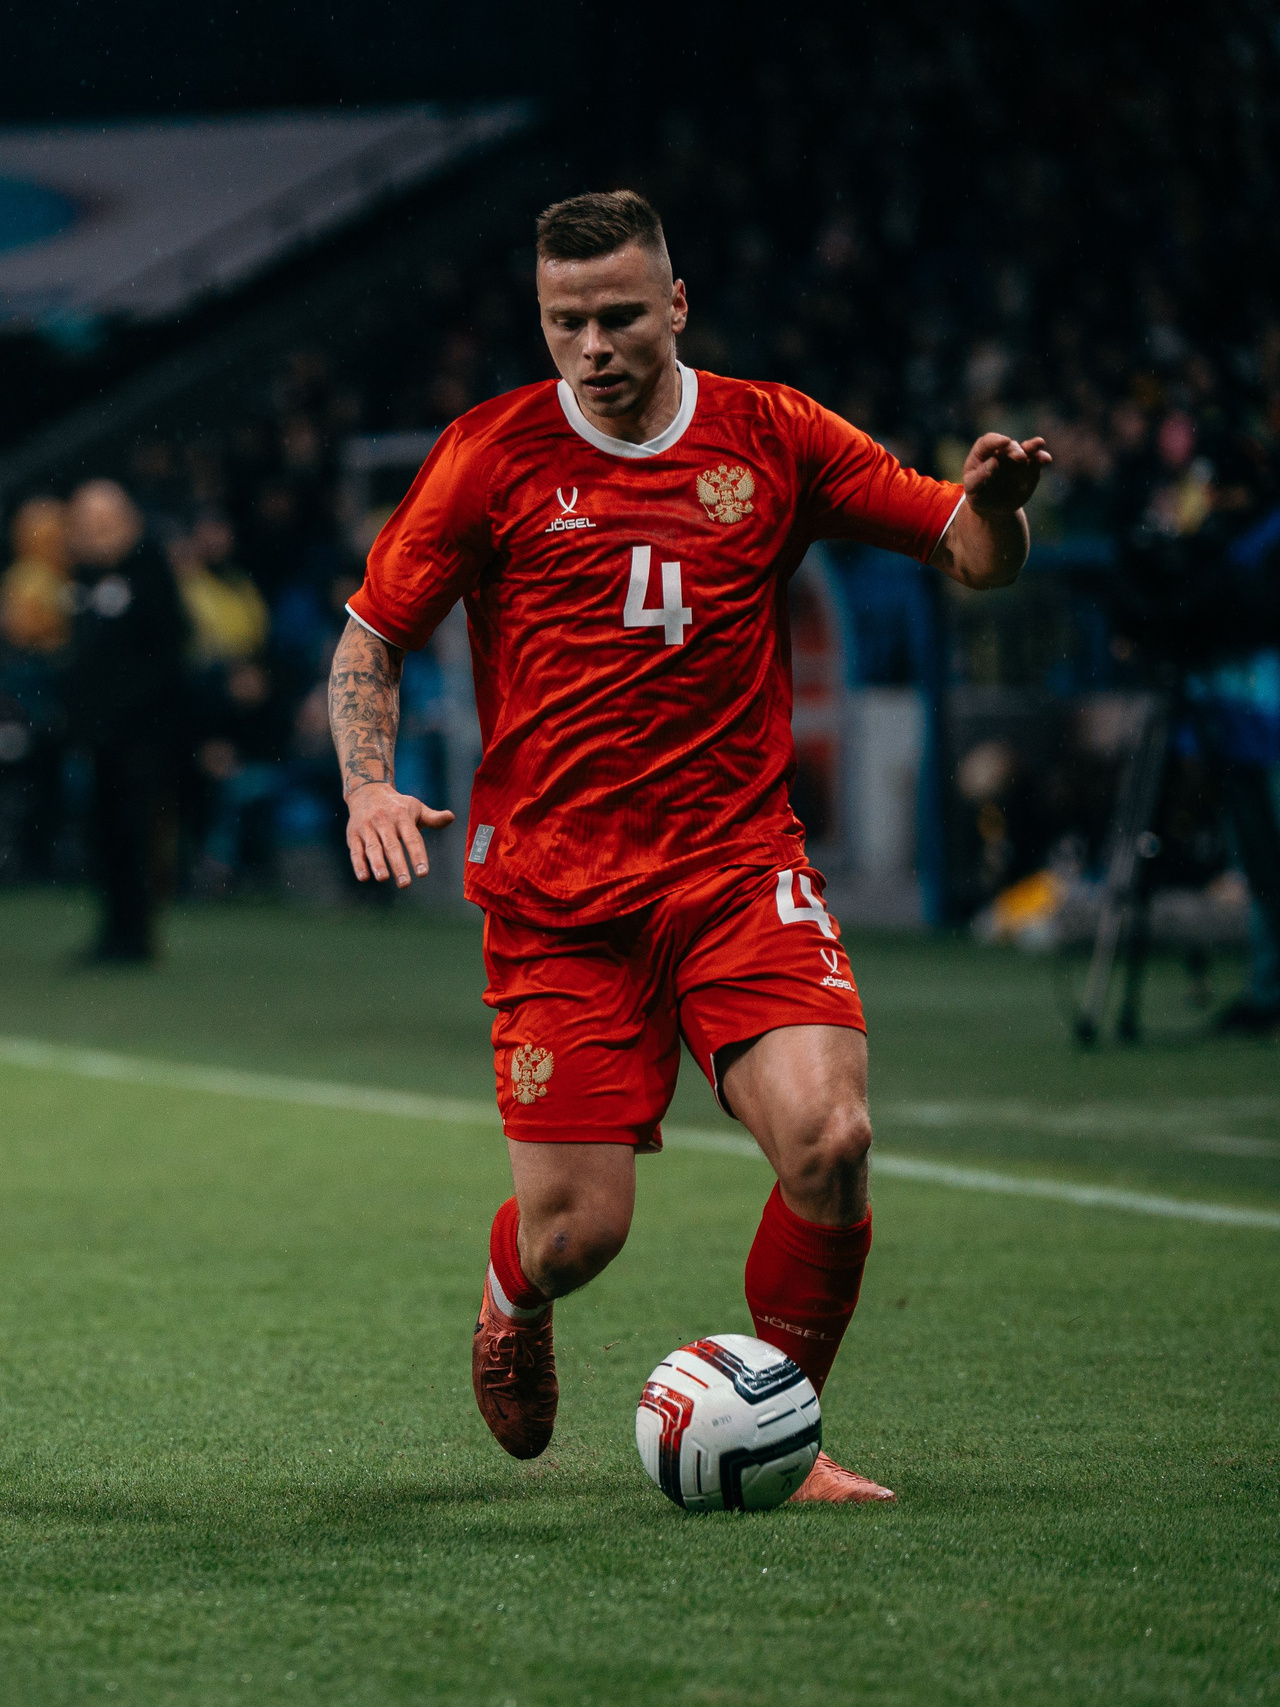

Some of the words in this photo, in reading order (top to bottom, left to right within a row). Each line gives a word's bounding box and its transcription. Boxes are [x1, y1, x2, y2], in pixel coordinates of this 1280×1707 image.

[545, 518, 597, 533] JÖGEL
[623, 545, 693, 645] 4
[776, 869, 838, 940] 4
